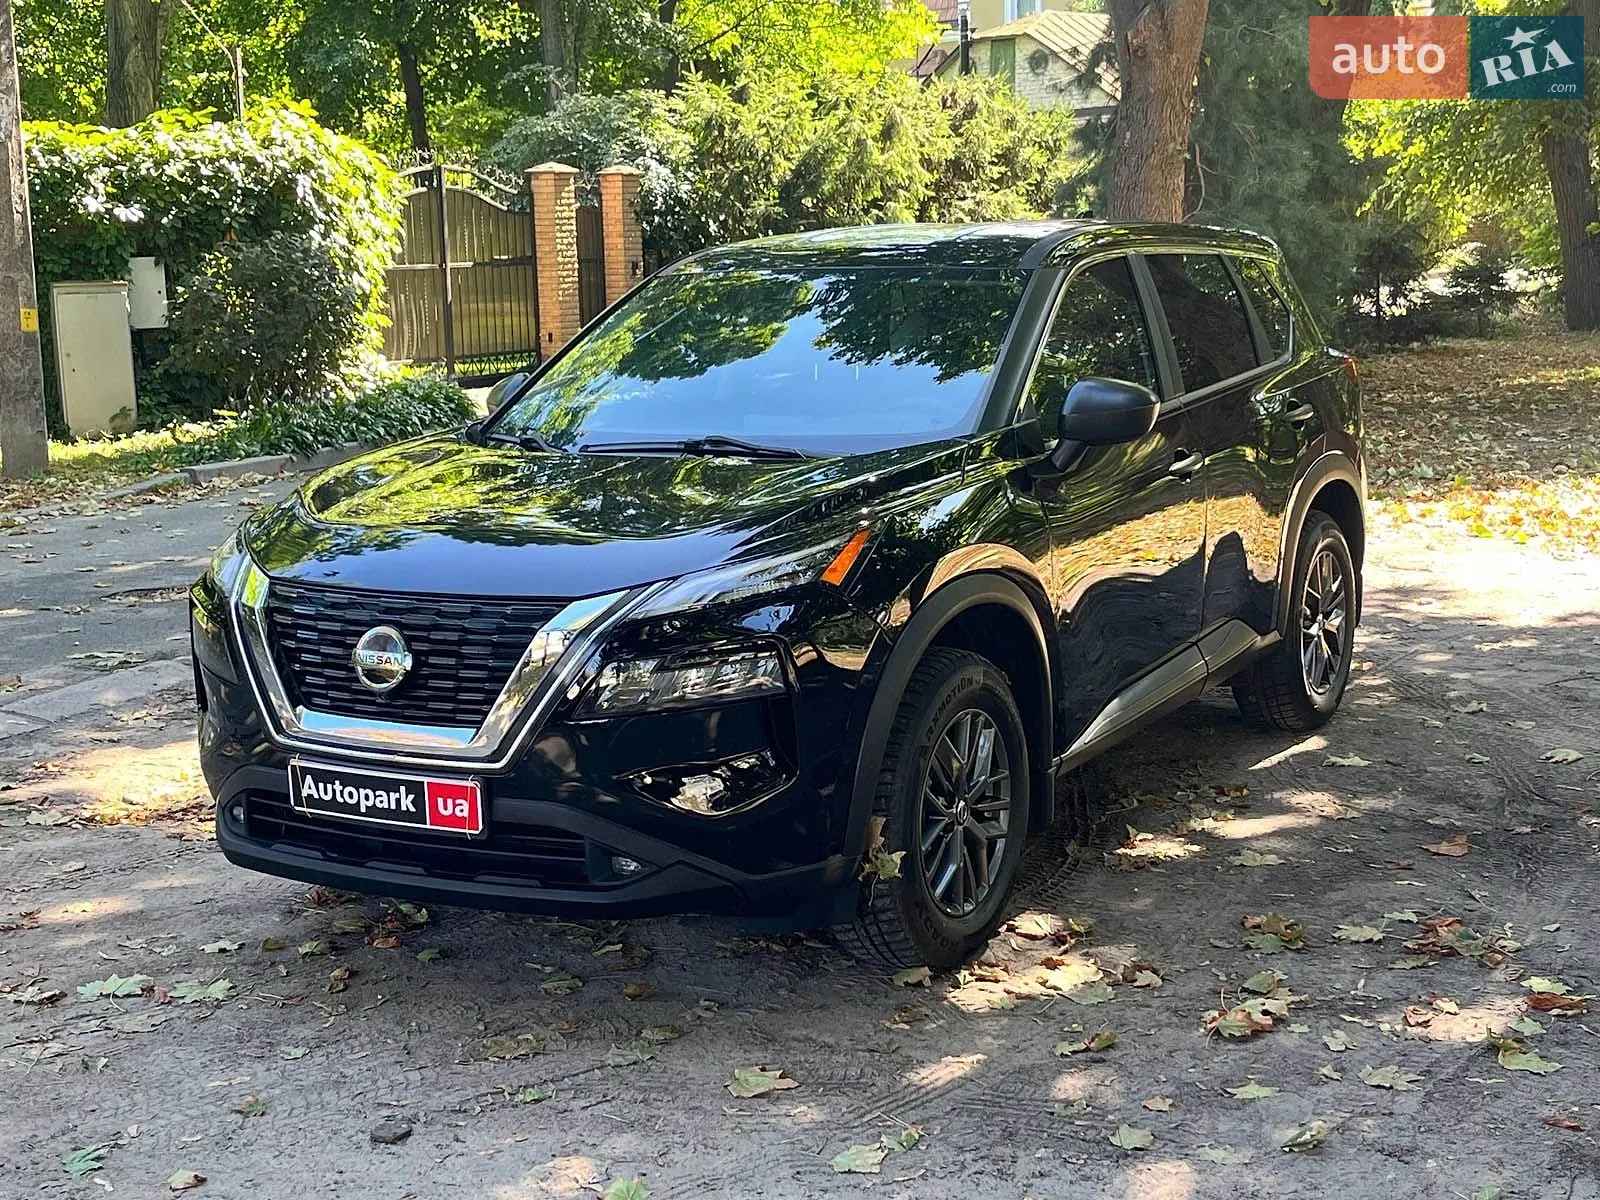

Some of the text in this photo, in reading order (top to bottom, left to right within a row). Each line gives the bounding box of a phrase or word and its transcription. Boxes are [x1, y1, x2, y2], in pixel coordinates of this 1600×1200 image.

[358, 652, 403, 667] NISSAN
[302, 774, 469, 818] Autopark ua
